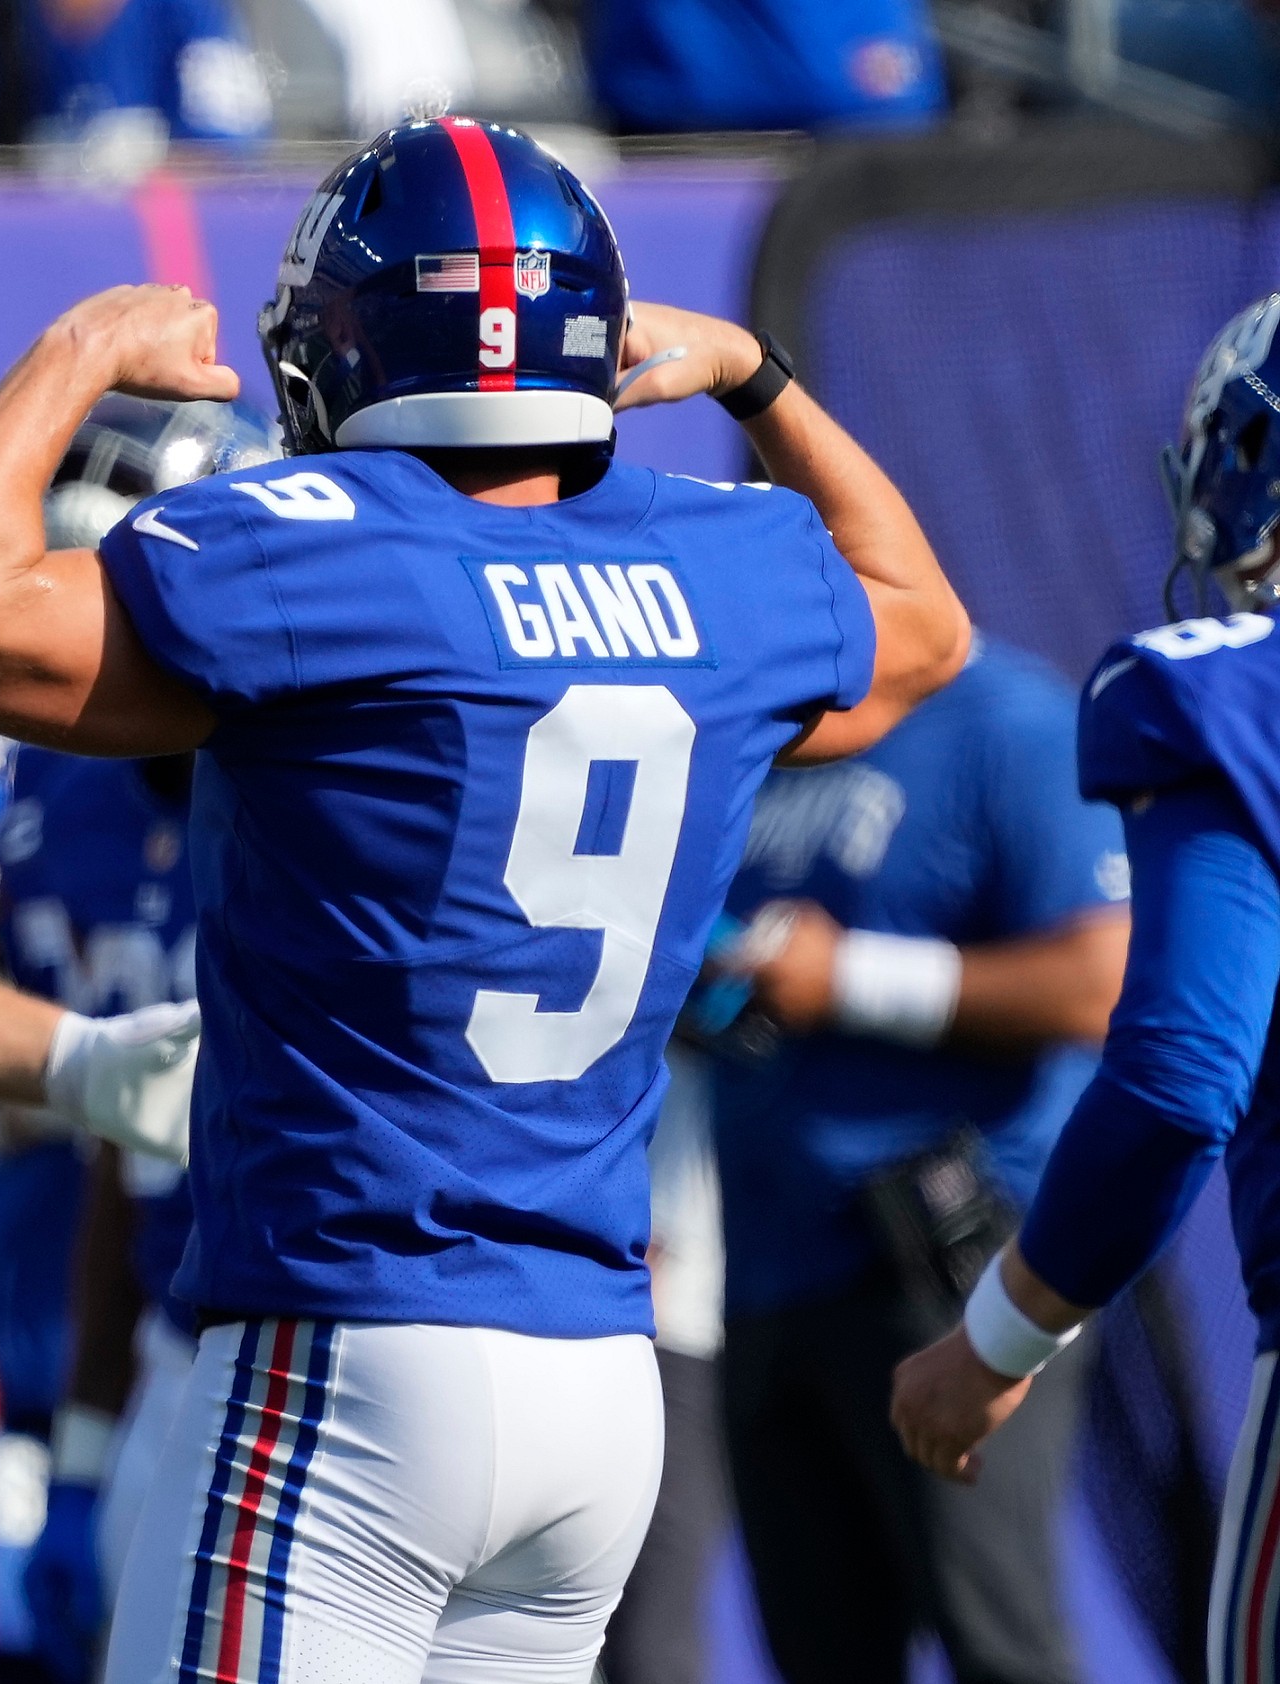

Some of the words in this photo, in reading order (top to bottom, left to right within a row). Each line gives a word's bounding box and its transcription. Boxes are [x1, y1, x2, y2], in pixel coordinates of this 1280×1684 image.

[520, 270, 545, 290] NFL
[478, 306, 516, 368] 9
[229, 472, 356, 520] 9
[483, 563, 700, 658] GANO
[464, 684, 697, 1083] 9
